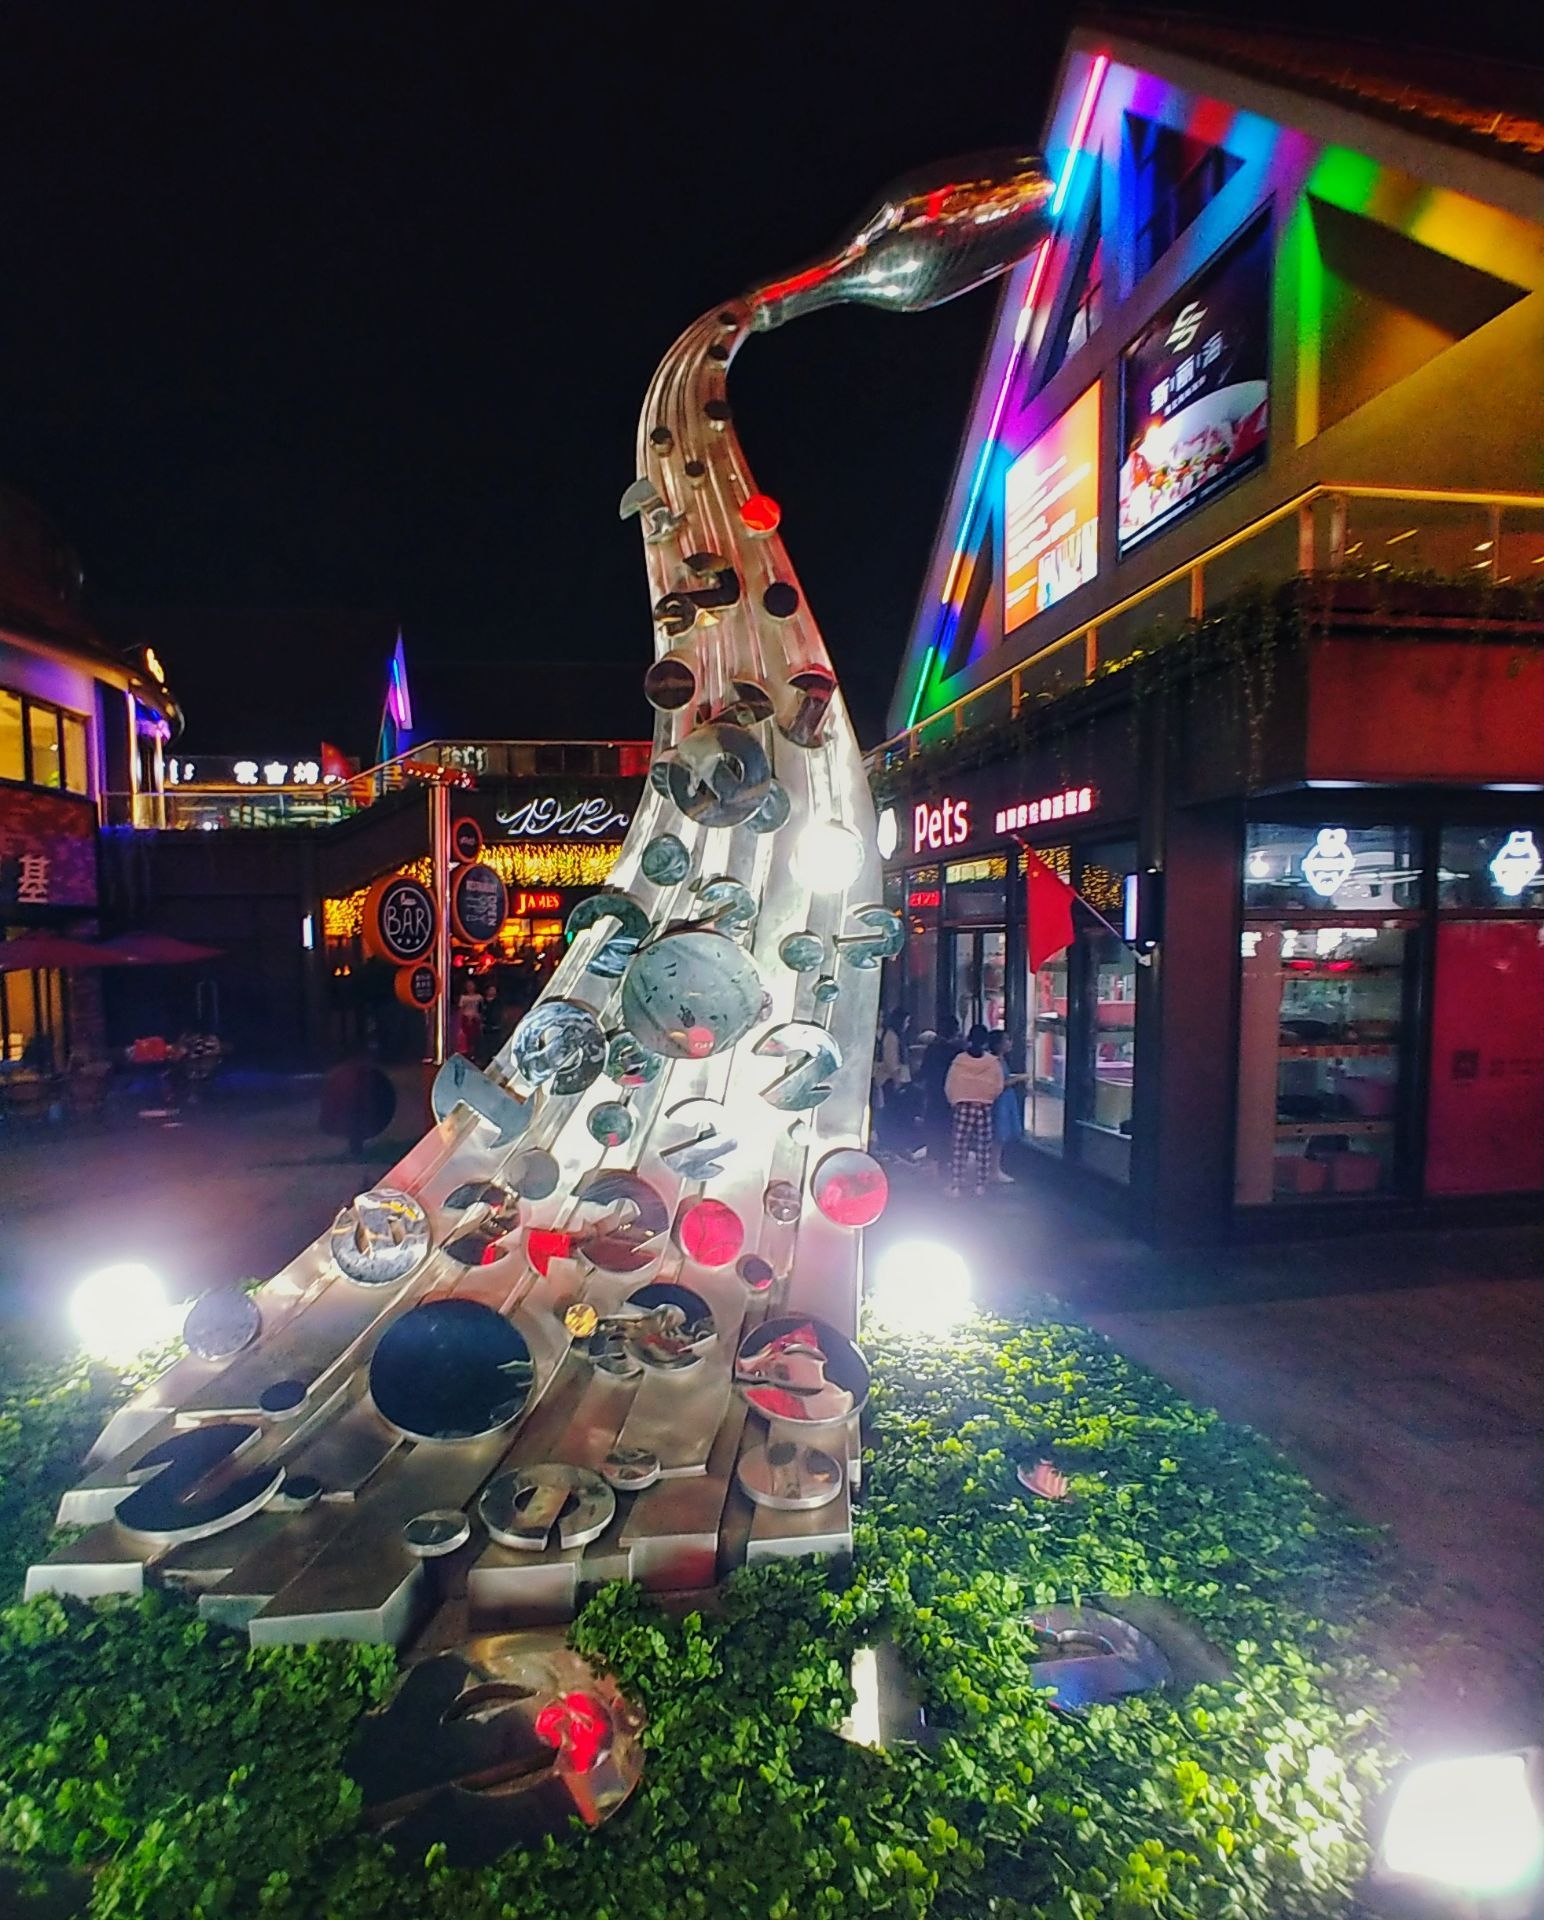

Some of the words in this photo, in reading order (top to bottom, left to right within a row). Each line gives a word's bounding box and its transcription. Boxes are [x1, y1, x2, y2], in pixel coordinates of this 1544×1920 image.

[496, 797, 630, 834] 1912
[914, 797, 968, 854] Pets
[487, 895, 498, 926] OPEN
[516, 893, 560, 914] JAMES
[387, 905, 428, 936] BAR
